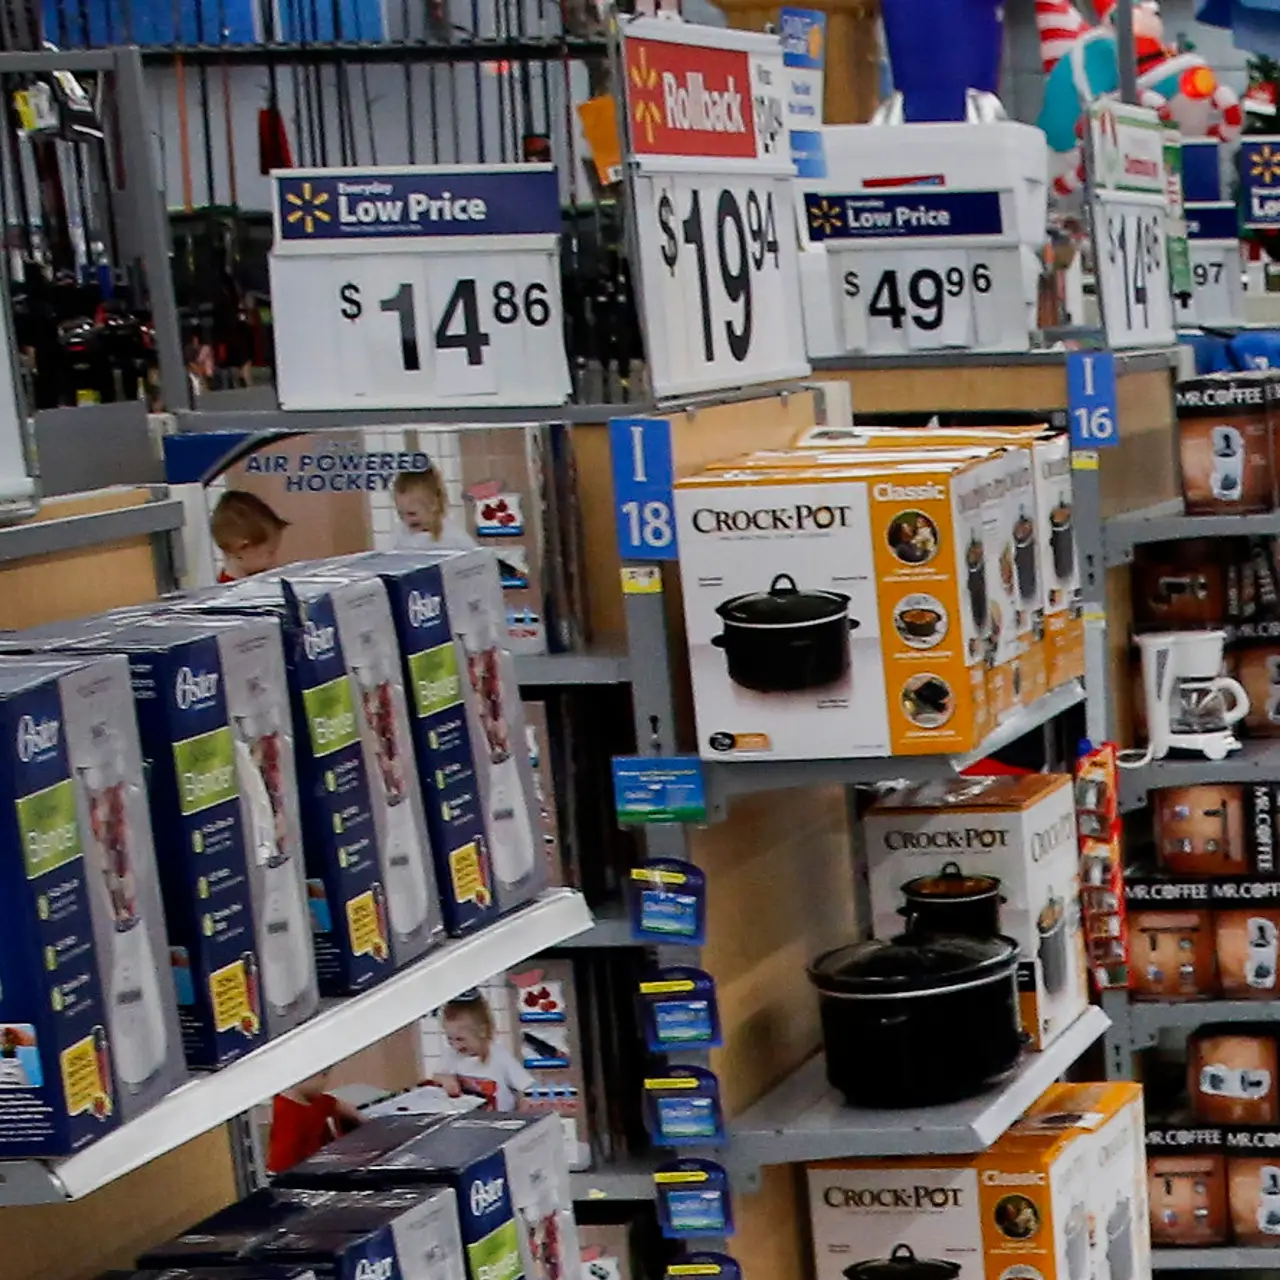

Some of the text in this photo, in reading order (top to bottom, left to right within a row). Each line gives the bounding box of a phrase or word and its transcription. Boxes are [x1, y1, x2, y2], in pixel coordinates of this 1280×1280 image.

[662, 71, 746, 134] Rollback
[337, 192, 488, 224] Low Price
[847, 204, 951, 229] Low Price
[1073, 406, 1114, 440] 16
[246, 453, 430, 473] AIR POWERED
[286, 474, 395, 493] HOCKEY
[873, 481, 946, 501] Classic
[621, 501, 674, 547] 18
[469, 1177, 505, 1217] Oster
